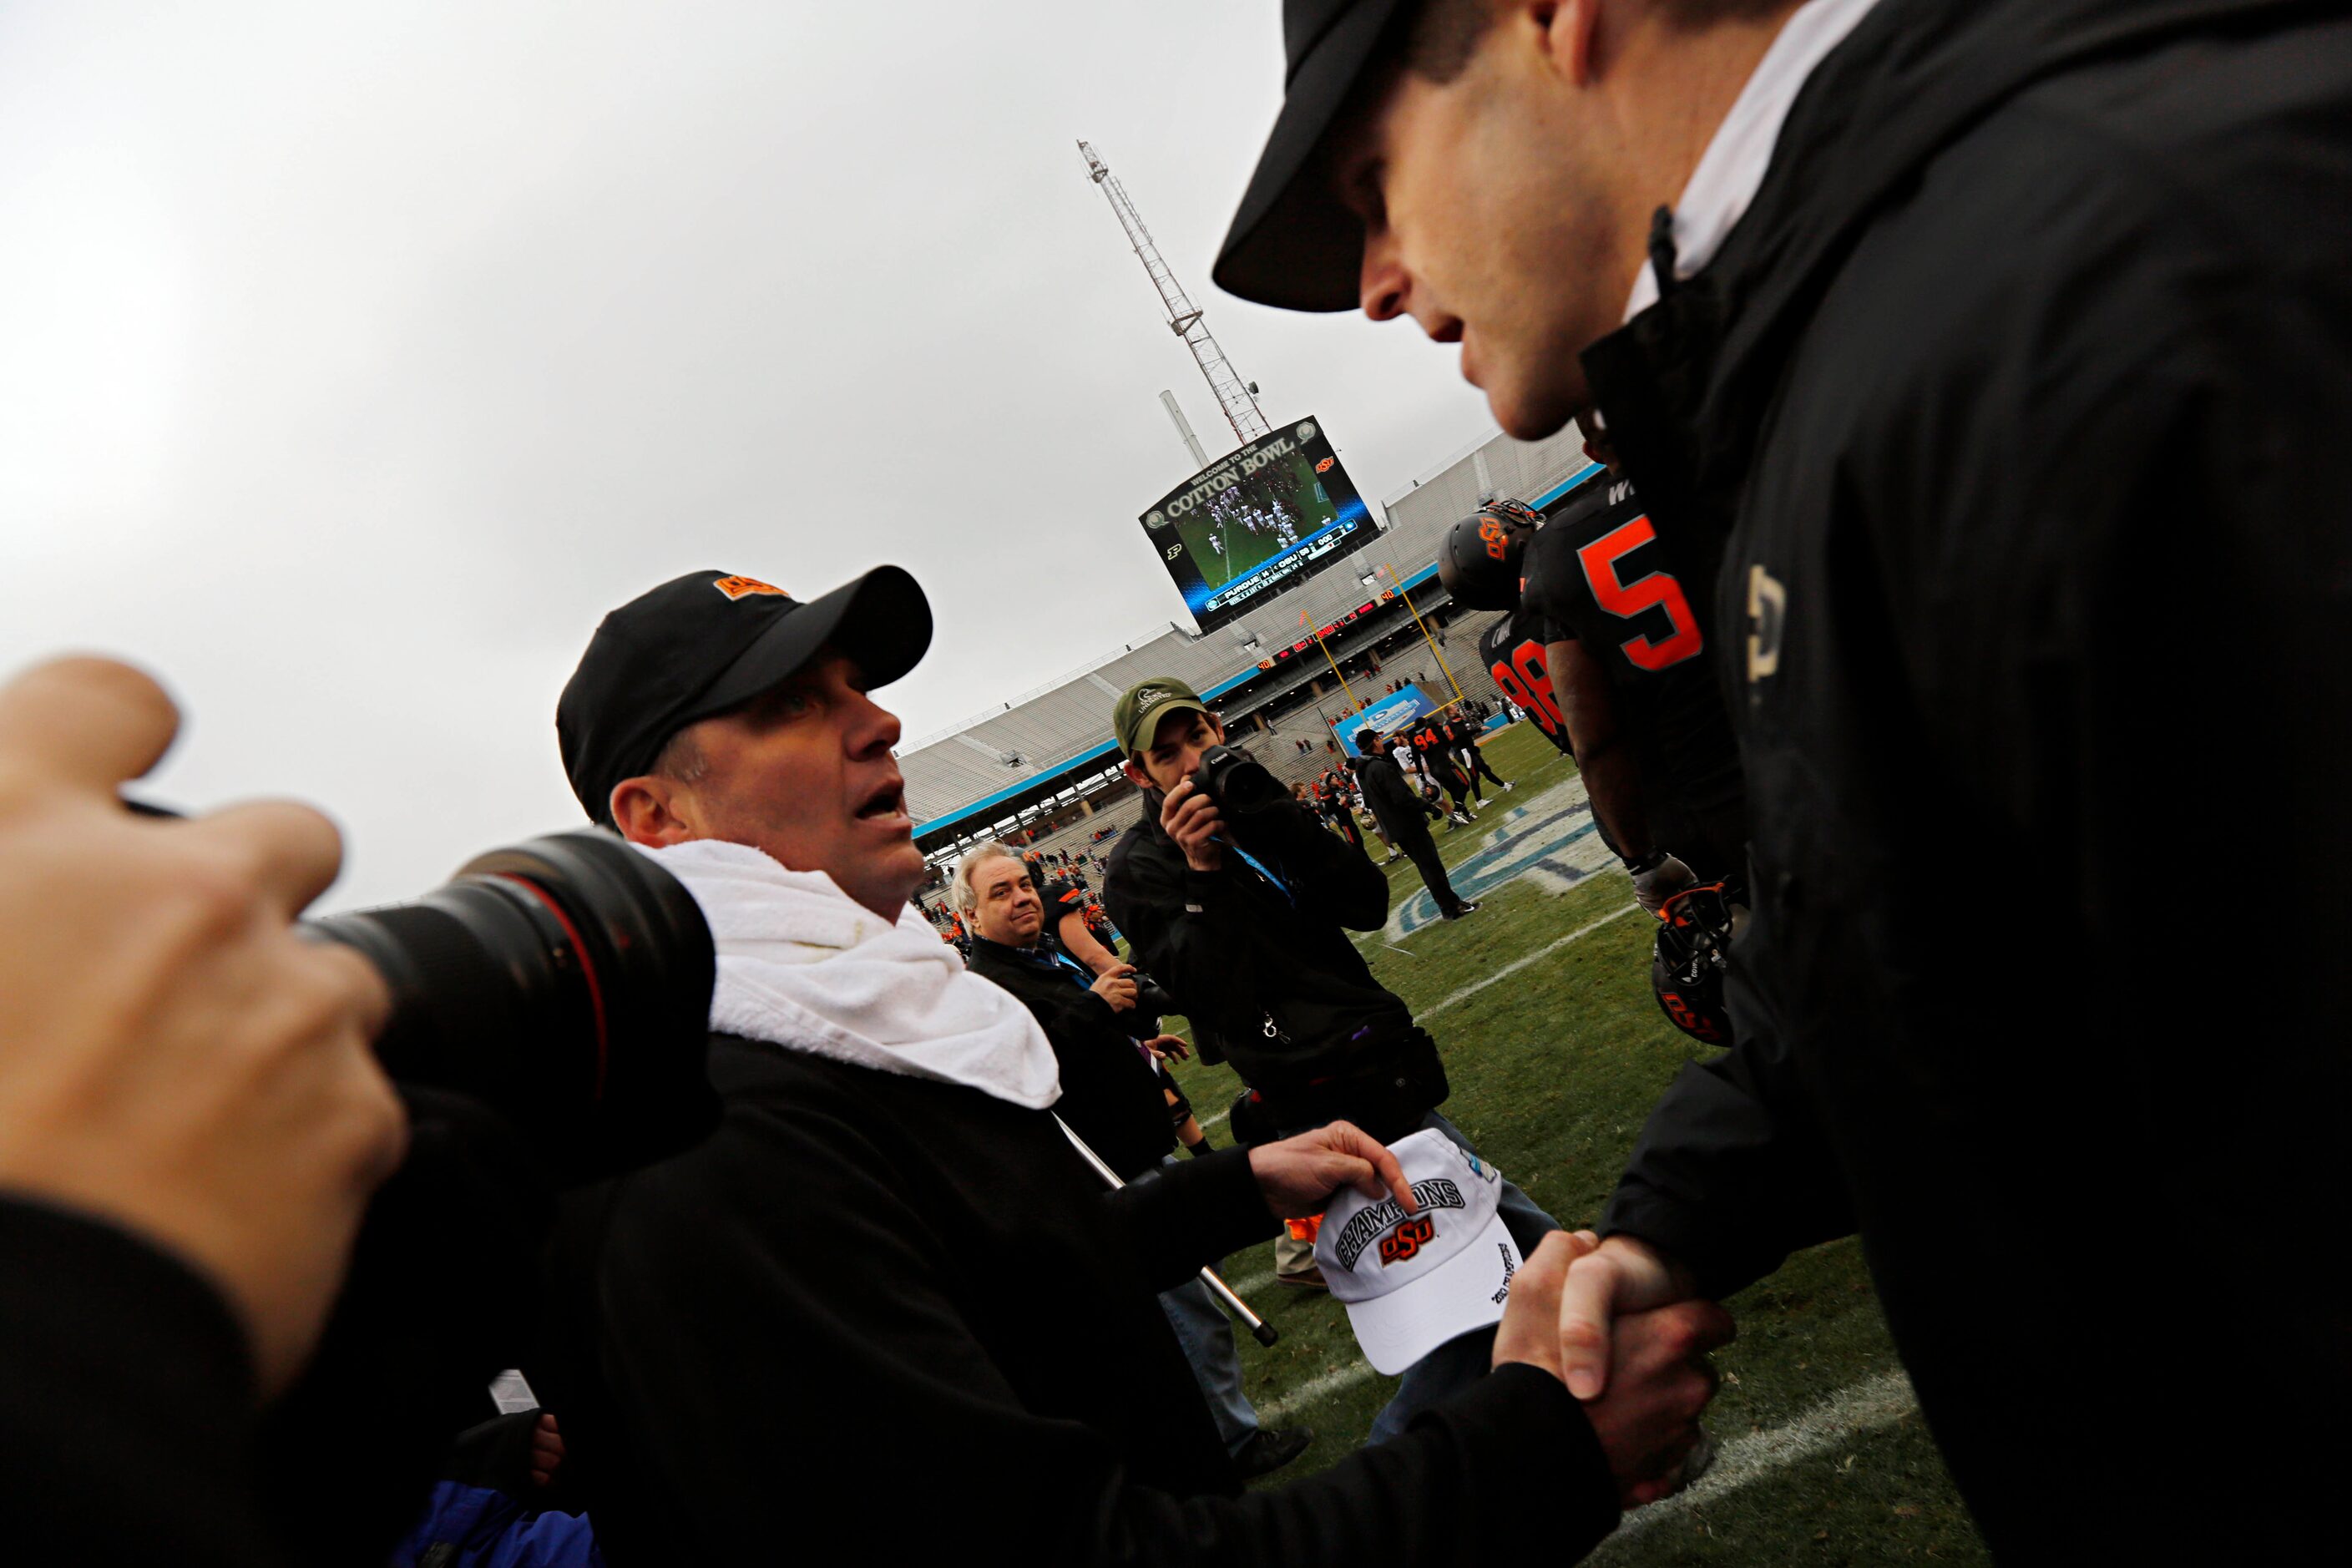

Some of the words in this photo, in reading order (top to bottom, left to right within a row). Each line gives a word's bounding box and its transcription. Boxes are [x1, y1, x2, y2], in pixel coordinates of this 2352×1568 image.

[1167, 466, 1241, 518] COTTON
[1239, 437, 1295, 476] BOWL
[1191, 460, 1231, 486] WELCOME
[1229, 453, 1241, 463] TO
[1242, 443, 1258, 457] THE
[1609, 478, 1636, 506] W
[1167, 544, 1182, 560] P
[1224, 575, 1260, 599] PURDUE
[1381, 589, 1394, 600] 40
[1576, 513, 1702, 670] 5
[1258, 660, 1270, 670] 40
[1491, 639, 1565, 736] 88
[1414, 728, 1439, 751] 94
[1378, 1212, 1435, 1268] OSU
